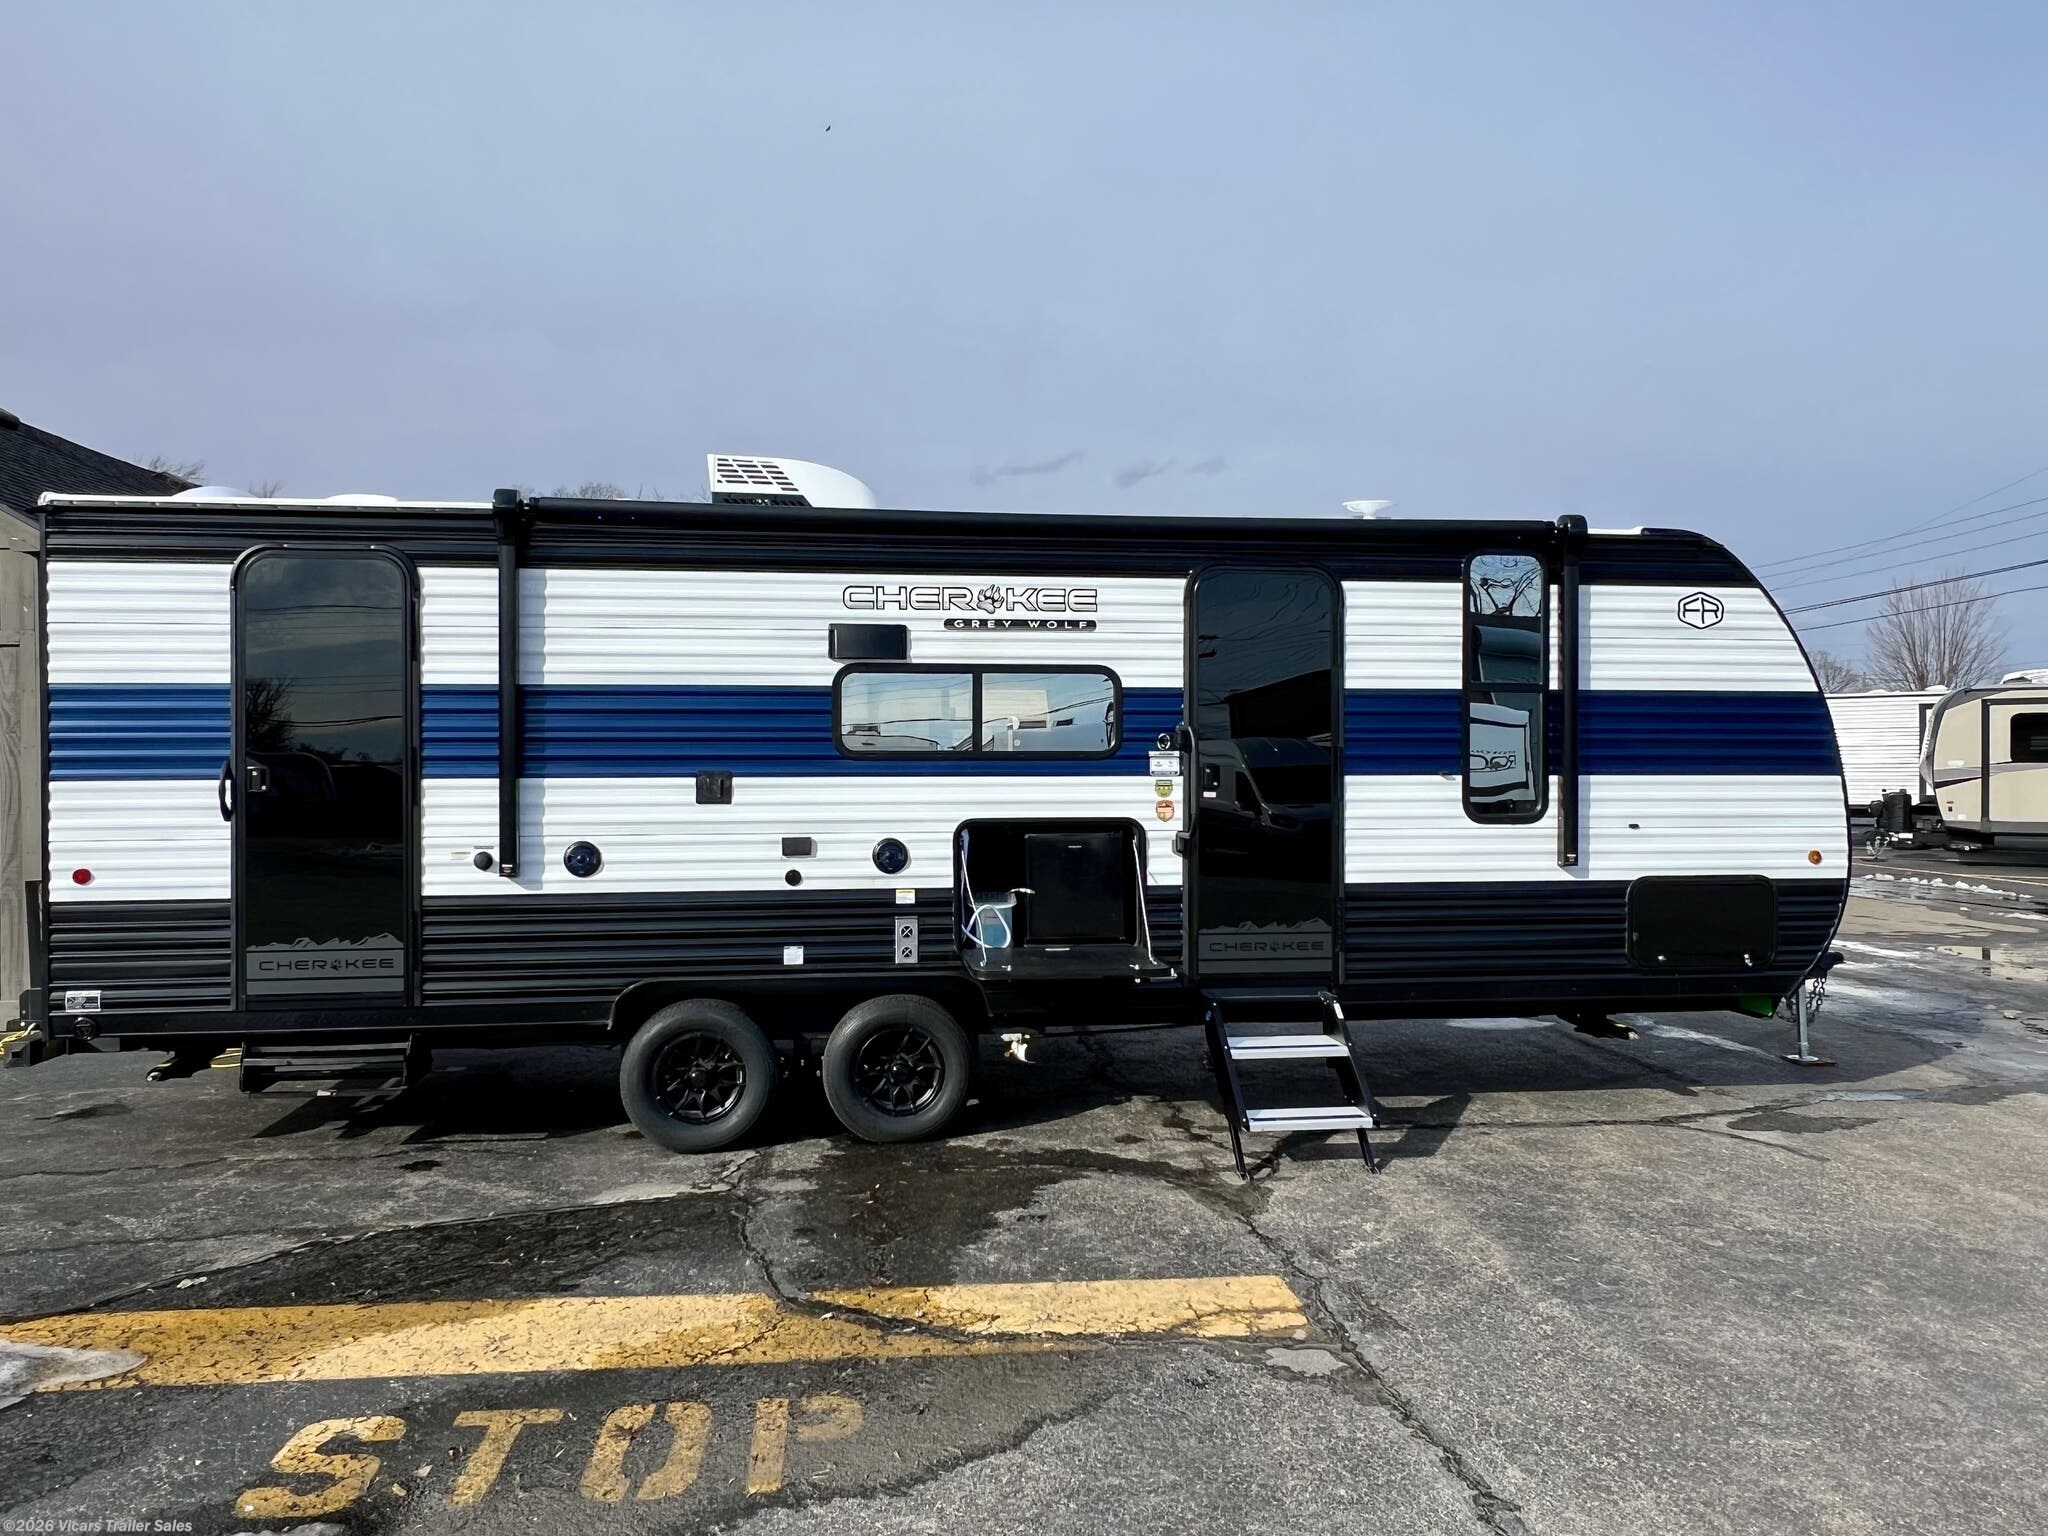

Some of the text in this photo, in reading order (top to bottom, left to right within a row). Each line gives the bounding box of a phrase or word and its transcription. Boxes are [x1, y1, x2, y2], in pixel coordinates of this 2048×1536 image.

[953, 619, 1089, 630] GREY WOLF
[234, 1398, 864, 1519] STOP
